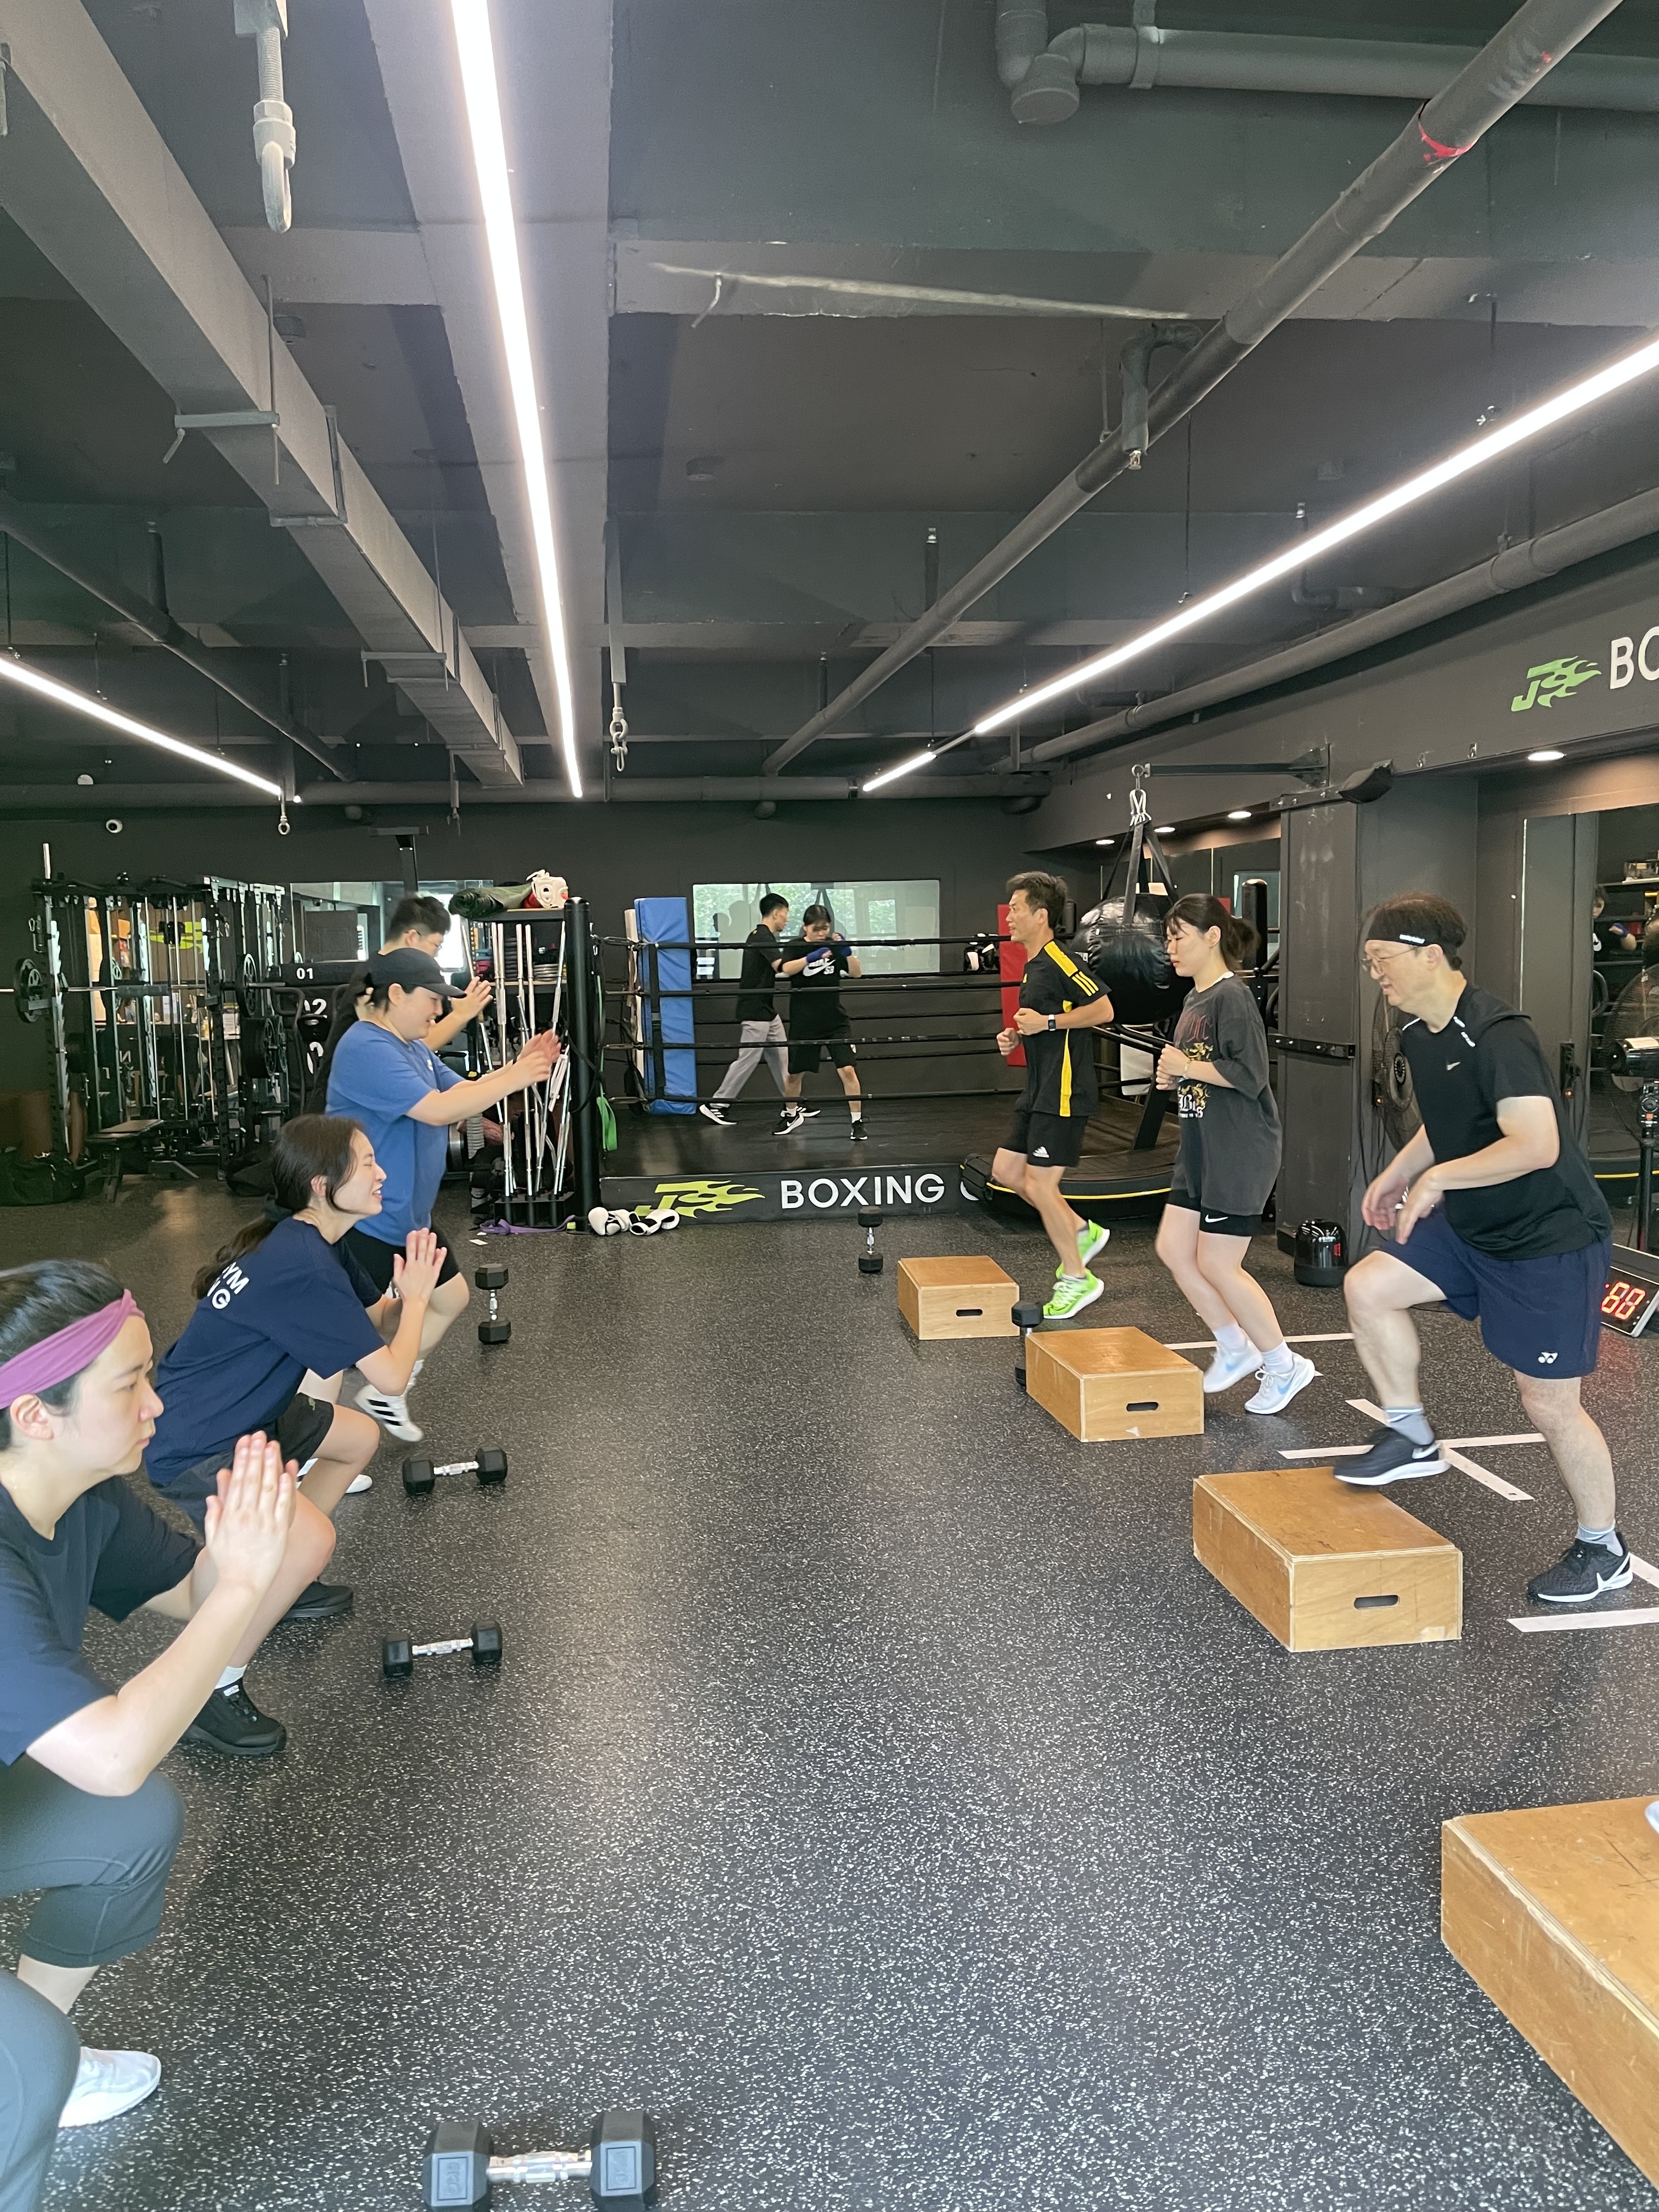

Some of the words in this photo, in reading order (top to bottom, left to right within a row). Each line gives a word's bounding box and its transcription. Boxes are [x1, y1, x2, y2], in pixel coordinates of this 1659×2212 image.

[296, 968, 313, 979] 01
[781, 1173, 945, 1209] BOXING
[222, 1262, 250, 1295] YM
